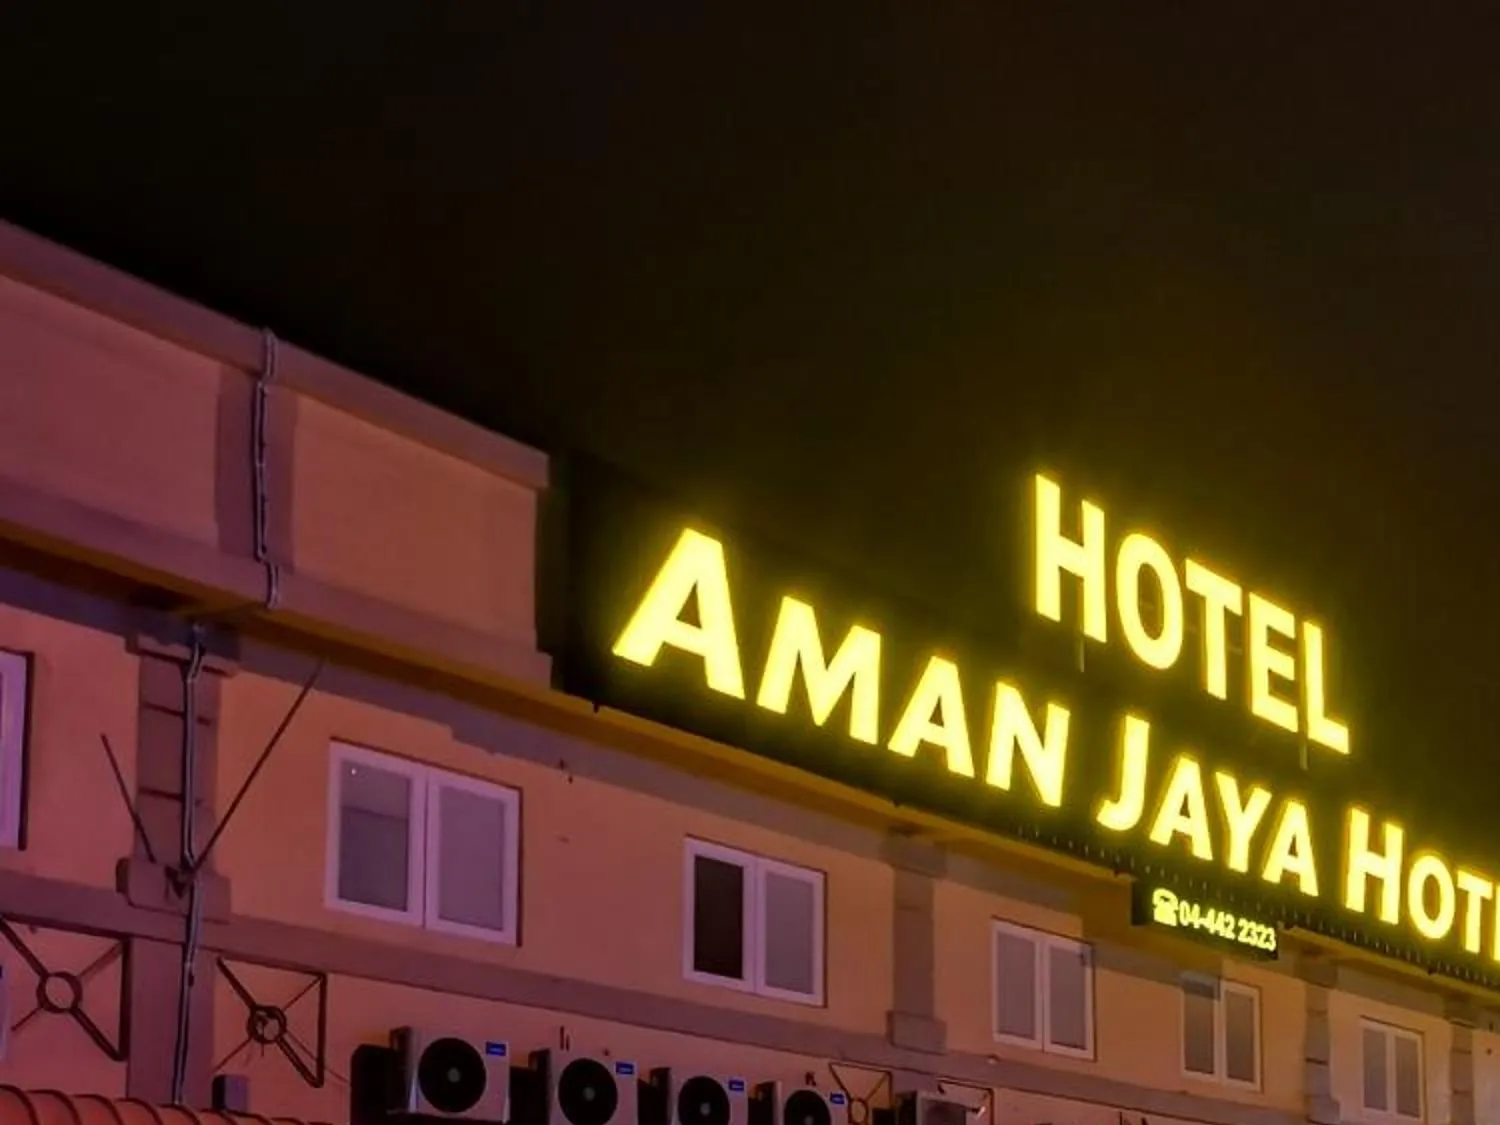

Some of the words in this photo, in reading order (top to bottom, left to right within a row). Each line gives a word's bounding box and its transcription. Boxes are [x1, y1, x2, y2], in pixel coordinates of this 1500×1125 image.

[612, 526, 1072, 808] AMAN
[1096, 714, 1320, 898] JAYA
[1034, 472, 1350, 756] HOTEL
